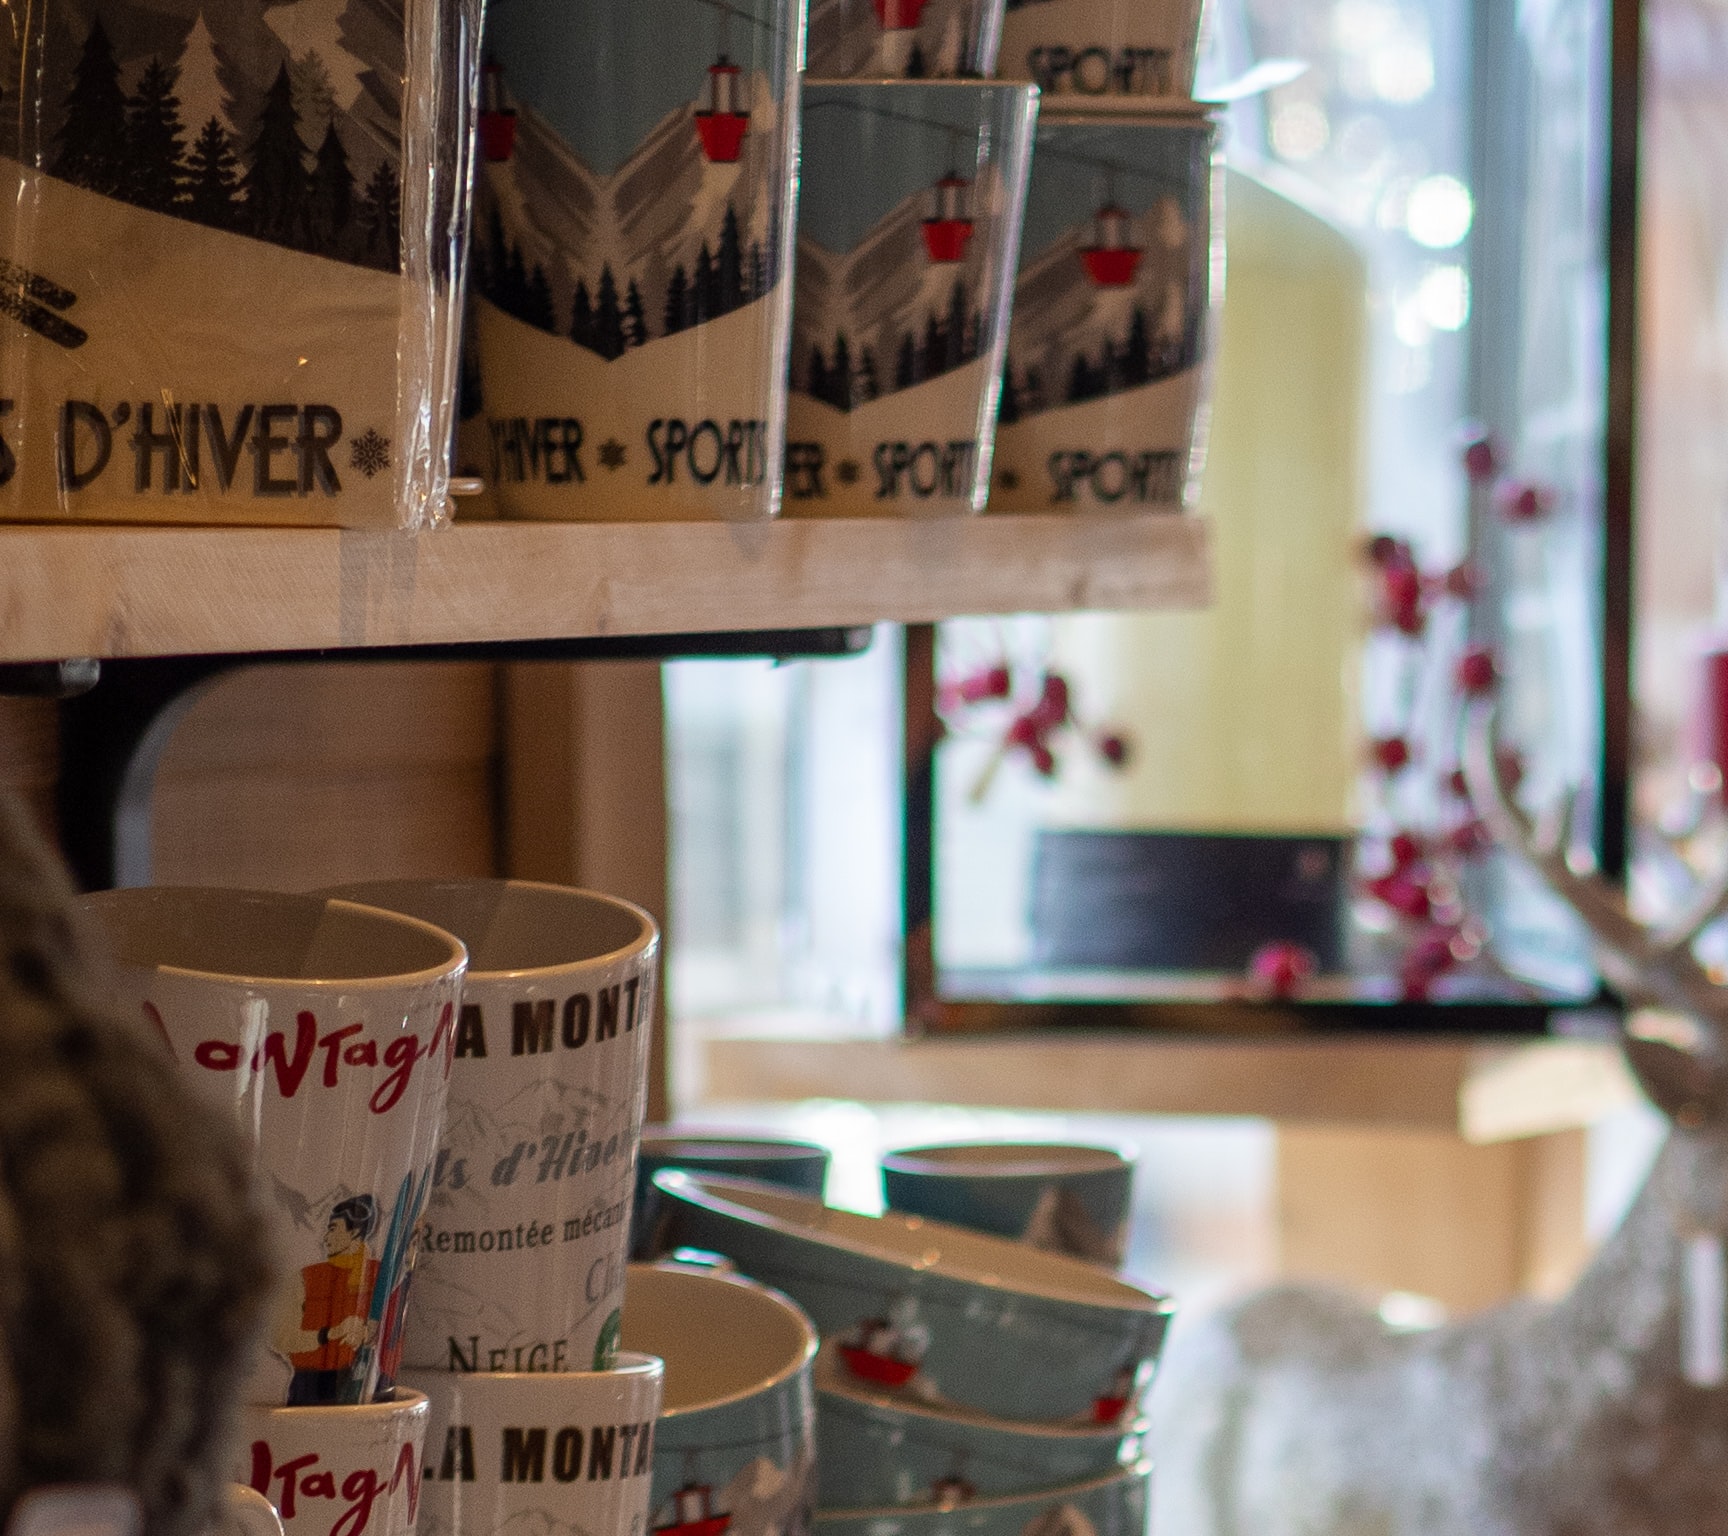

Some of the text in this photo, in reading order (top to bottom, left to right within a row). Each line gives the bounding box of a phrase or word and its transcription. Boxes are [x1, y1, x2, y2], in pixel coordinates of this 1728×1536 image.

[60, 400, 343, 497] D'HIVER
[454, 976, 640, 1059] A MONT
[421, 1219, 554, 1254] Remontée
[423, 1425, 475, 1483] A
